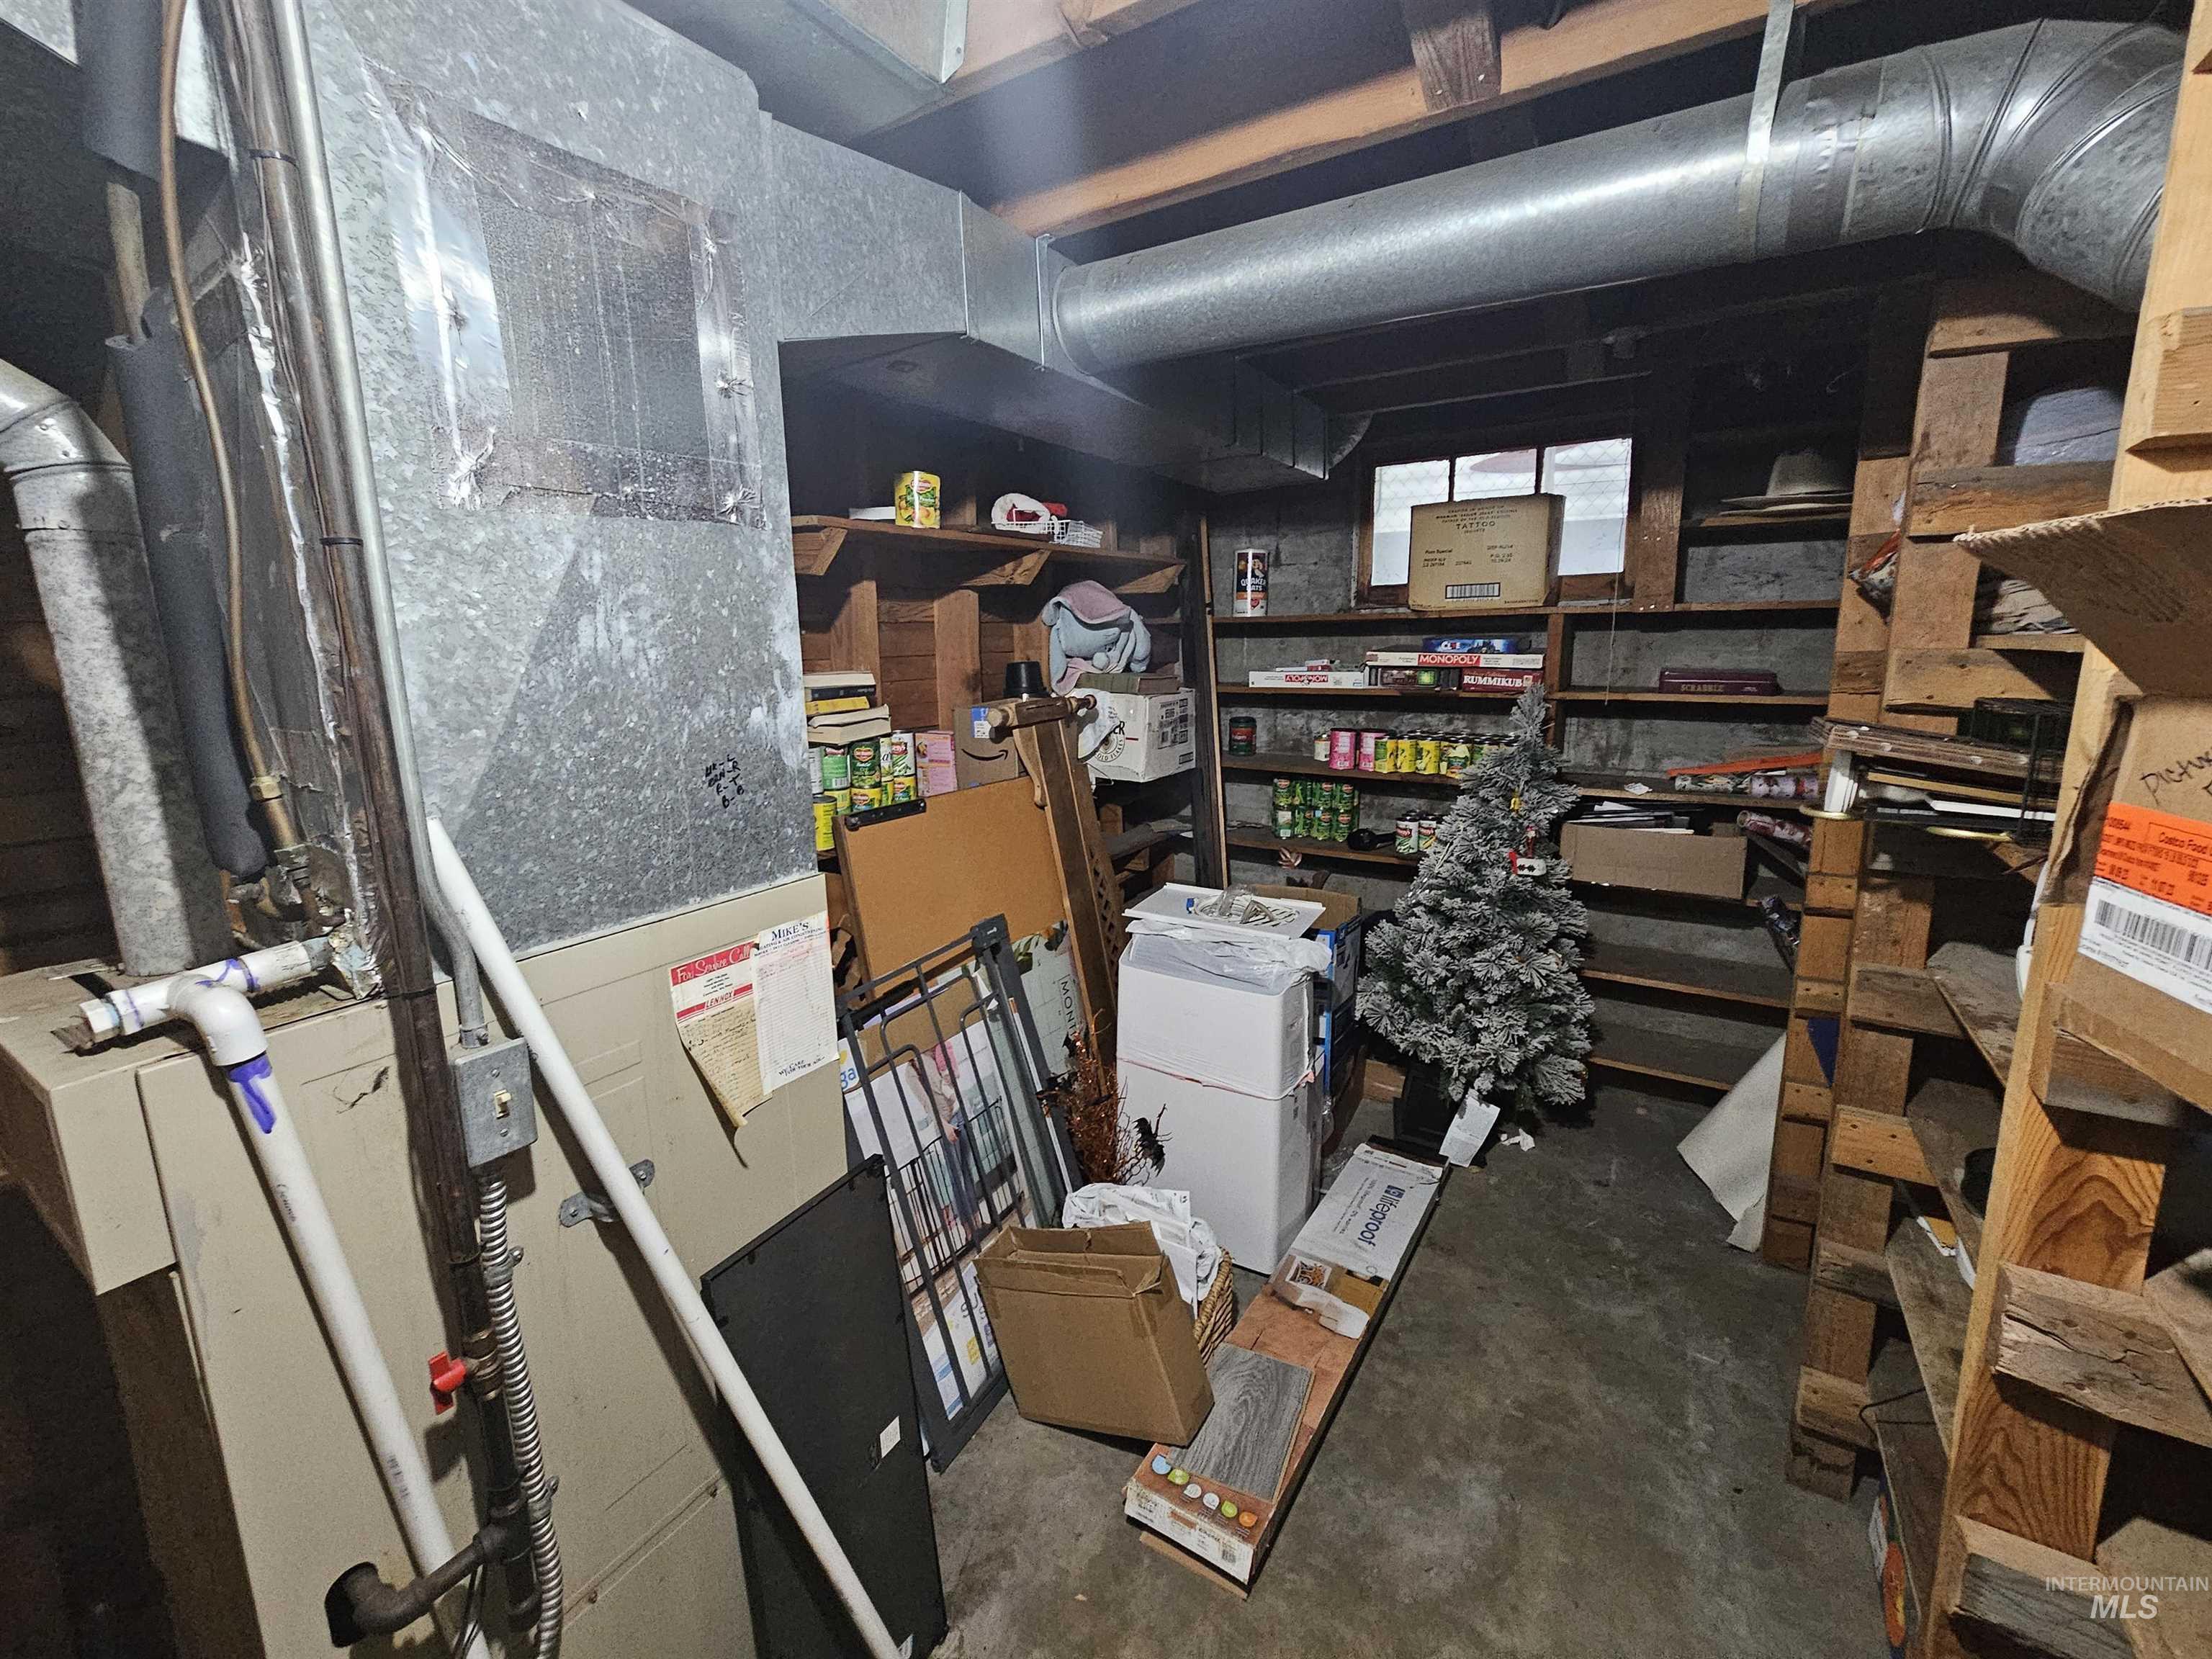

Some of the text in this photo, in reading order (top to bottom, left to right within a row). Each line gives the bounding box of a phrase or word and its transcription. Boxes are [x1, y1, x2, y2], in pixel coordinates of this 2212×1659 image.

[1456, 521, 1496, 530] TATTOO
[1419, 654, 1479, 665] MONOPOLY
[1463, 675, 1523, 687] RUMMIKUB
[2159, 832, 2185, 848] Costco
[2187, 839, 2208, 854] Food
[771, 922, 809, 941] MIKE'S
[695, 956, 728, 976] Service
[706, 991, 733, 1007] LENNOX
[1357, 1194, 1400, 1246] lifeproof
